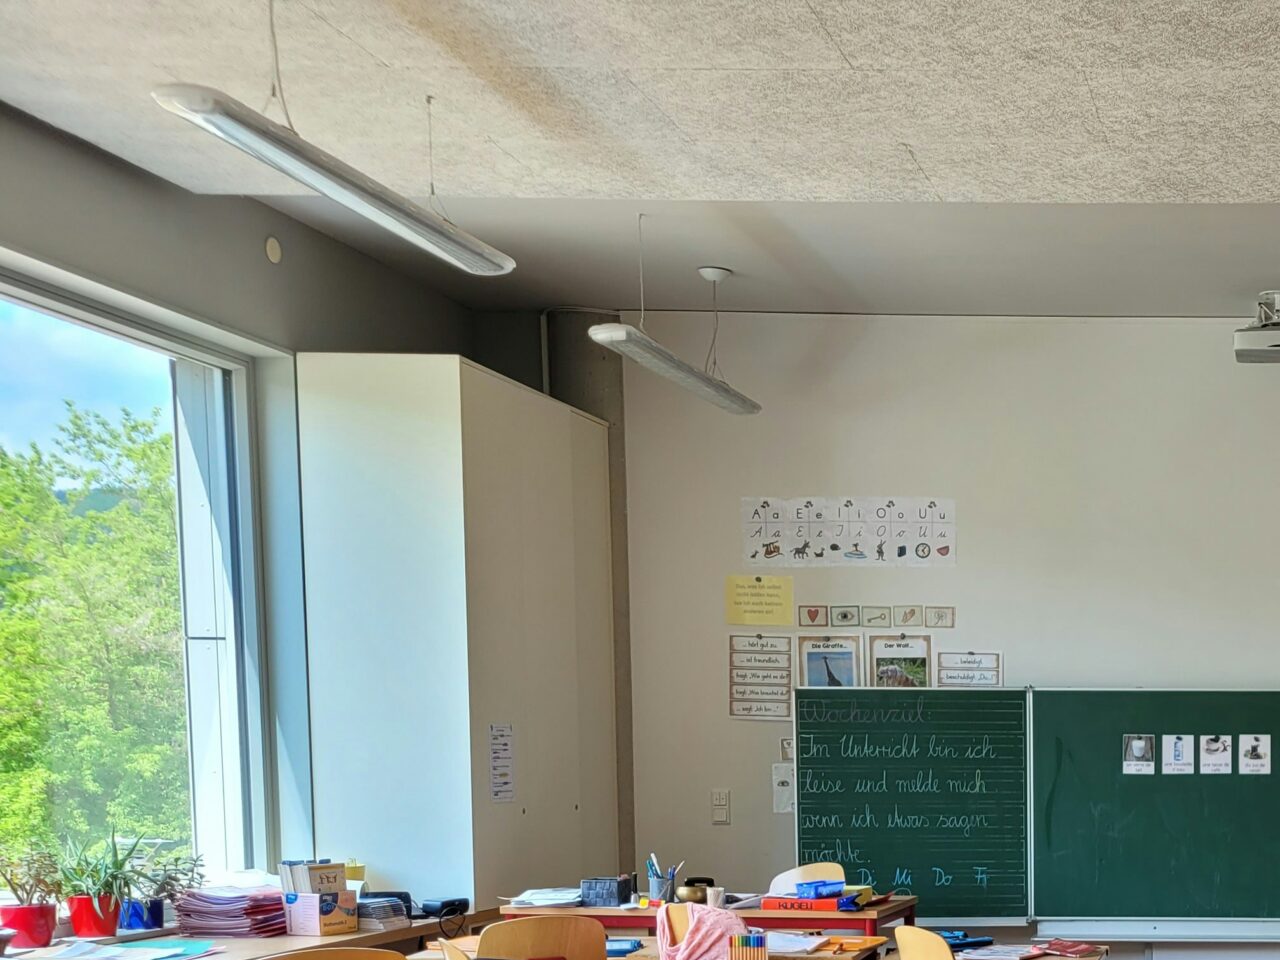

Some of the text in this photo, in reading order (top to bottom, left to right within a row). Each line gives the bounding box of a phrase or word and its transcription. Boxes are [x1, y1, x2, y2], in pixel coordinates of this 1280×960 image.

[752, 509, 761, 519] A
[797, 508, 802, 519] E
[876, 508, 886, 518] O
[919, 508, 927, 519] U
[801, 696, 932, 723] Wochenziel:
[801, 734, 996, 759] Im Unterricht bin ich
[802, 768, 846, 793] leise
[855, 770, 888, 793] und
[896, 769, 941, 793] melde
[801, 803, 988, 837] wenn ich etwas sagen
[856, 868, 877, 886] Di
[892, 867, 912, 886] Mi
[932, 867, 953, 886] Do
